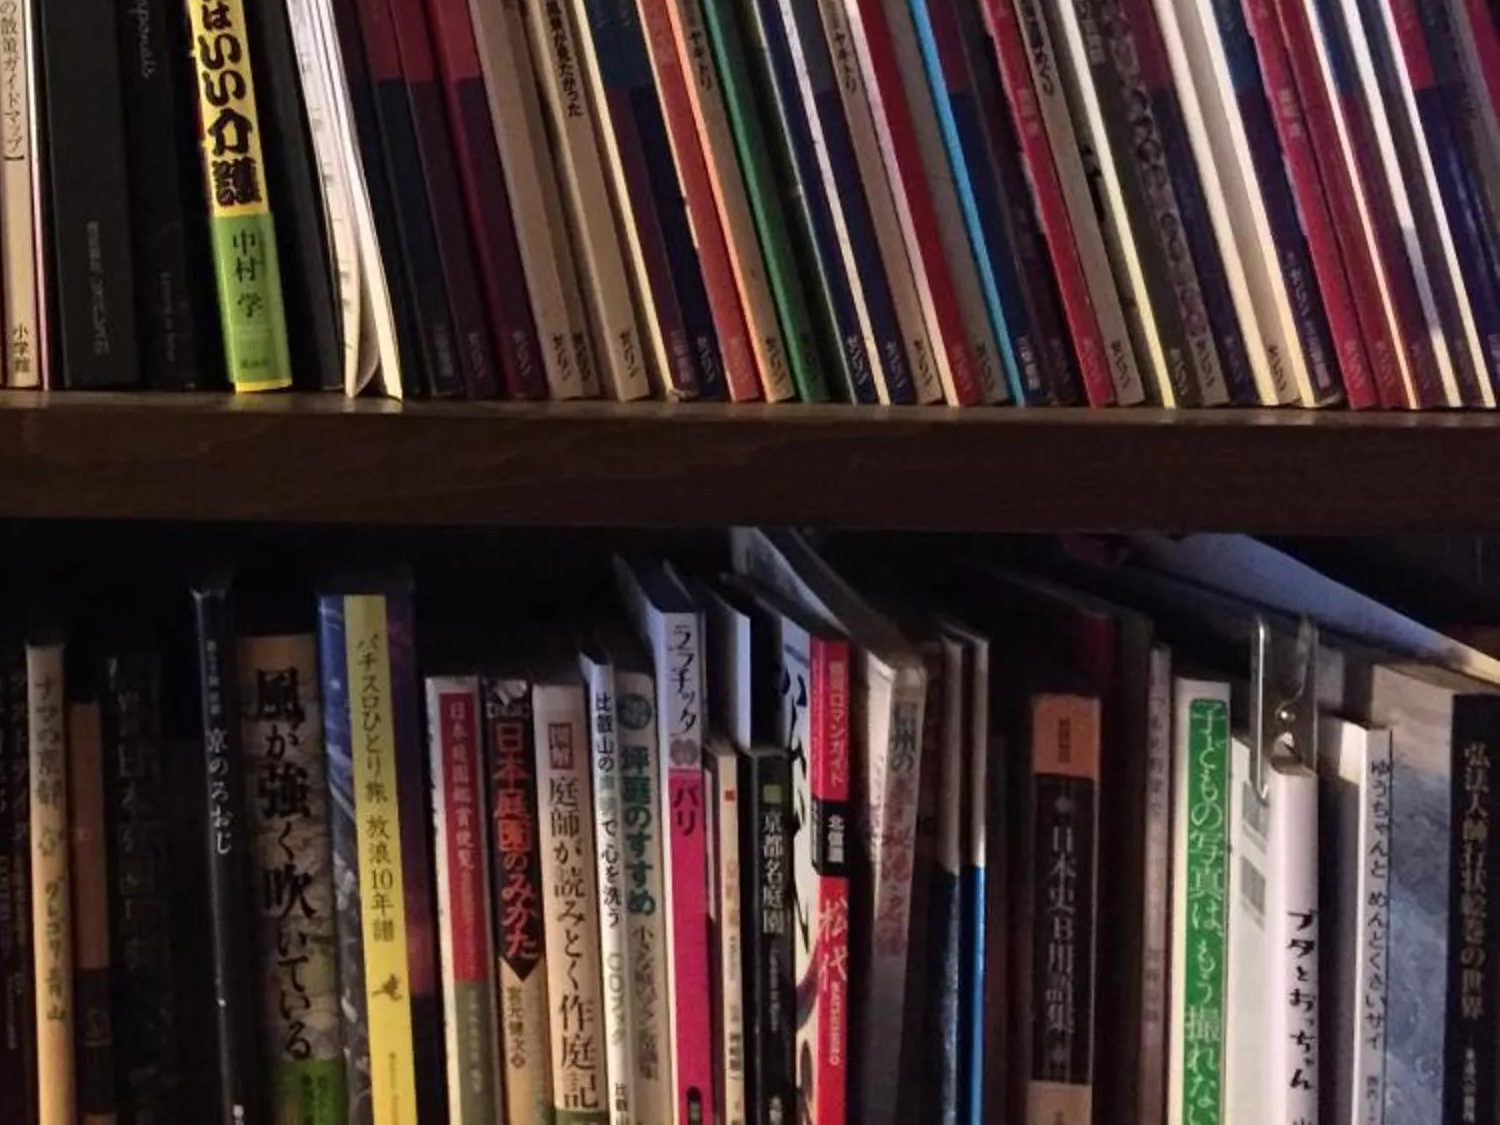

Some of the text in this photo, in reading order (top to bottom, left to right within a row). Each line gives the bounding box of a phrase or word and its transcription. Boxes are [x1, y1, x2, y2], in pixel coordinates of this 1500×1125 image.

[231, 229, 264, 320] 中村学
[355, 634, 391, 806] パチスロひとり旅
[255, 667, 318, 1064] 風が強く吹いている
[494, 720, 541, 960] 日本庭園のみかた
[619, 745, 657, 918] 坪庭のすすめ
[761, 812, 787, 935] 京都名庭園
[548, 776, 599, 1109] 庭師が読みとく作庭記
[818, 896, 847, 989] 松代
[1045, 824, 1077, 1035] 日本史B用語集
